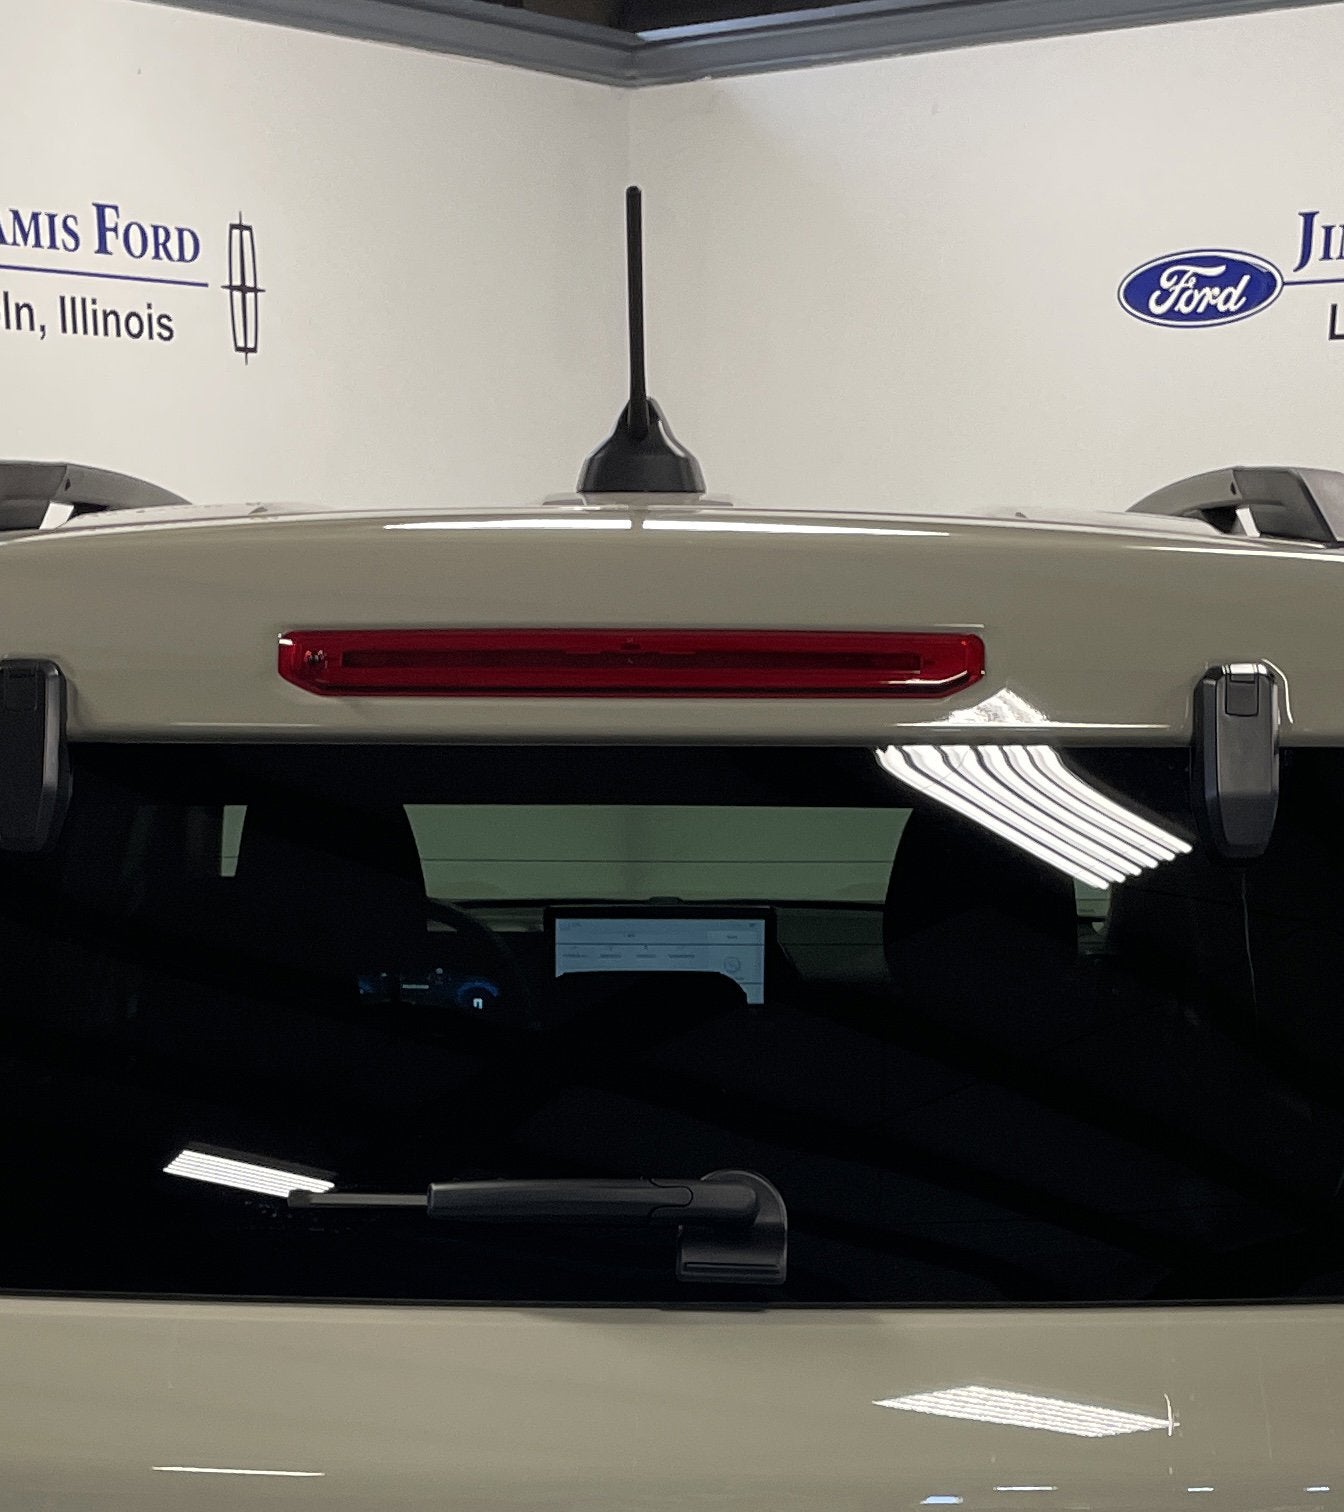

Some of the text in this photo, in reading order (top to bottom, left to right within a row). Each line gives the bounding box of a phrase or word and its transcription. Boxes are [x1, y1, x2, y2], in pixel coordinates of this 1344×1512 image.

[92, 203, 200, 264] FORD
[1149, 264, 1245, 314] Ford
[59, 295, 175, 341] Illinois
